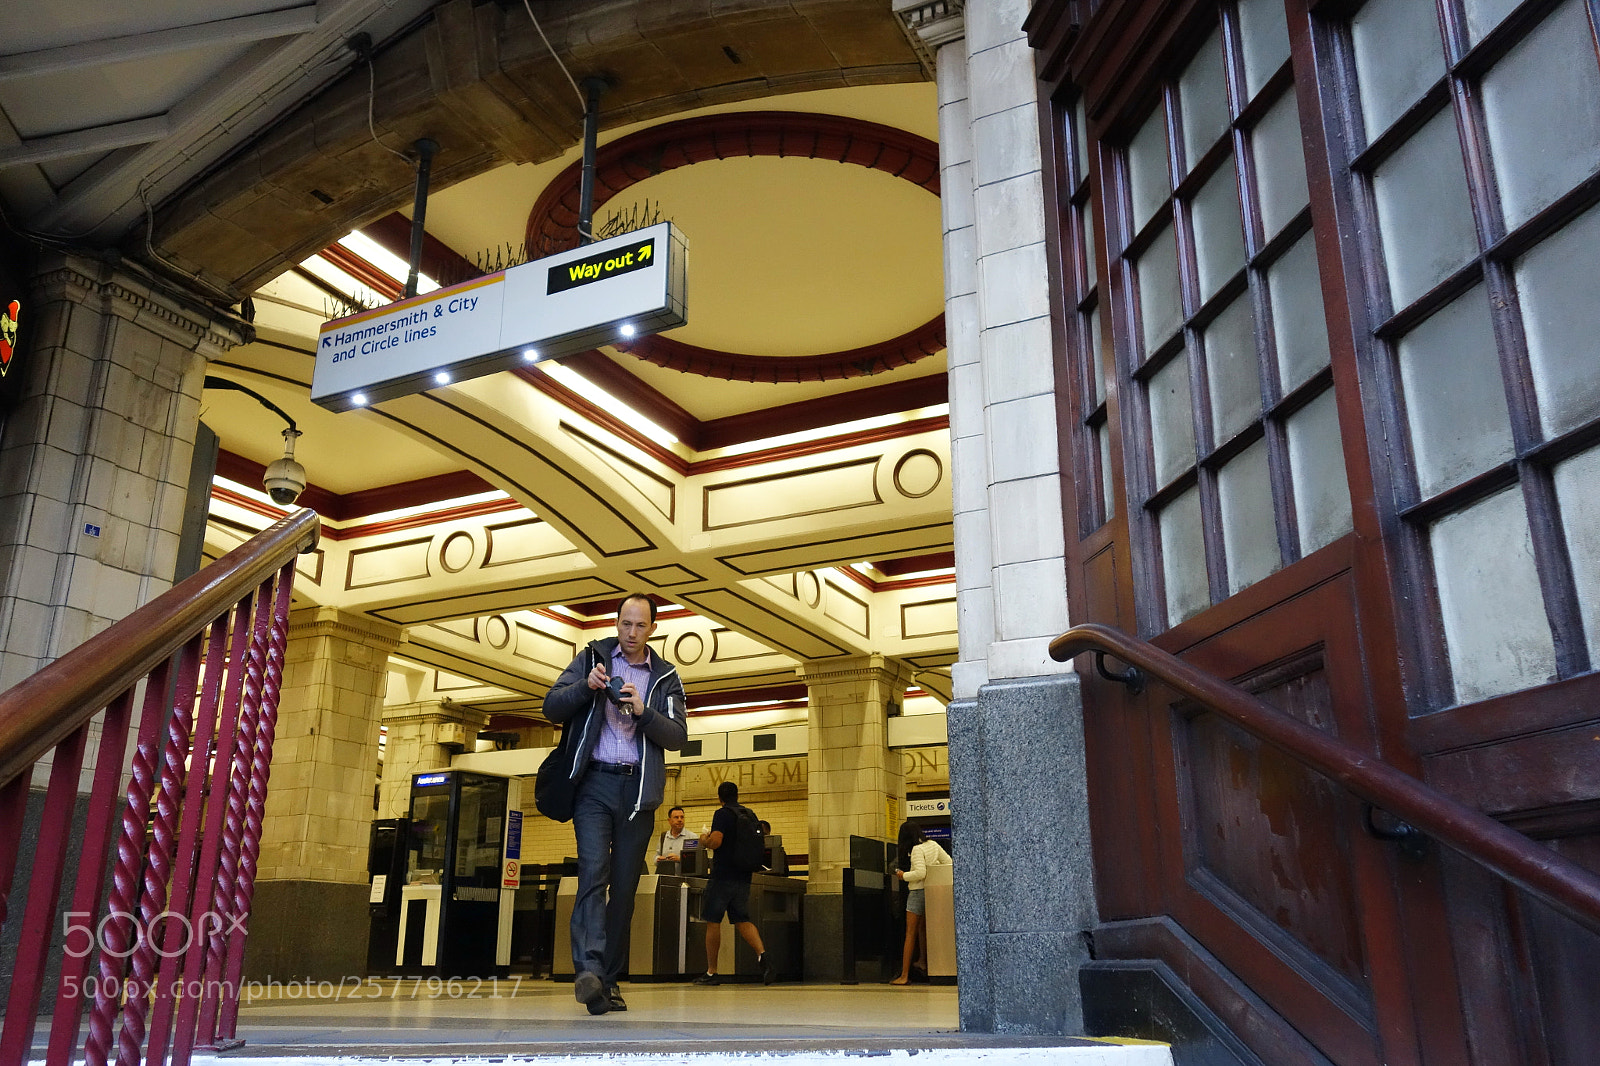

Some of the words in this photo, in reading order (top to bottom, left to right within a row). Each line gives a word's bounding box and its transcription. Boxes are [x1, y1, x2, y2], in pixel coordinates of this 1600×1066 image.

[568, 262, 603, 282] Way
[604, 252, 634, 272] out
[334, 309, 428, 347] Hammersmith
[433, 304, 443, 318] &
[448, 296, 479, 314] City
[332, 345, 356, 363] and
[361, 335, 399, 355] Circle
[404, 325, 437, 344] lines
[909, 802, 935, 812] Tickets
